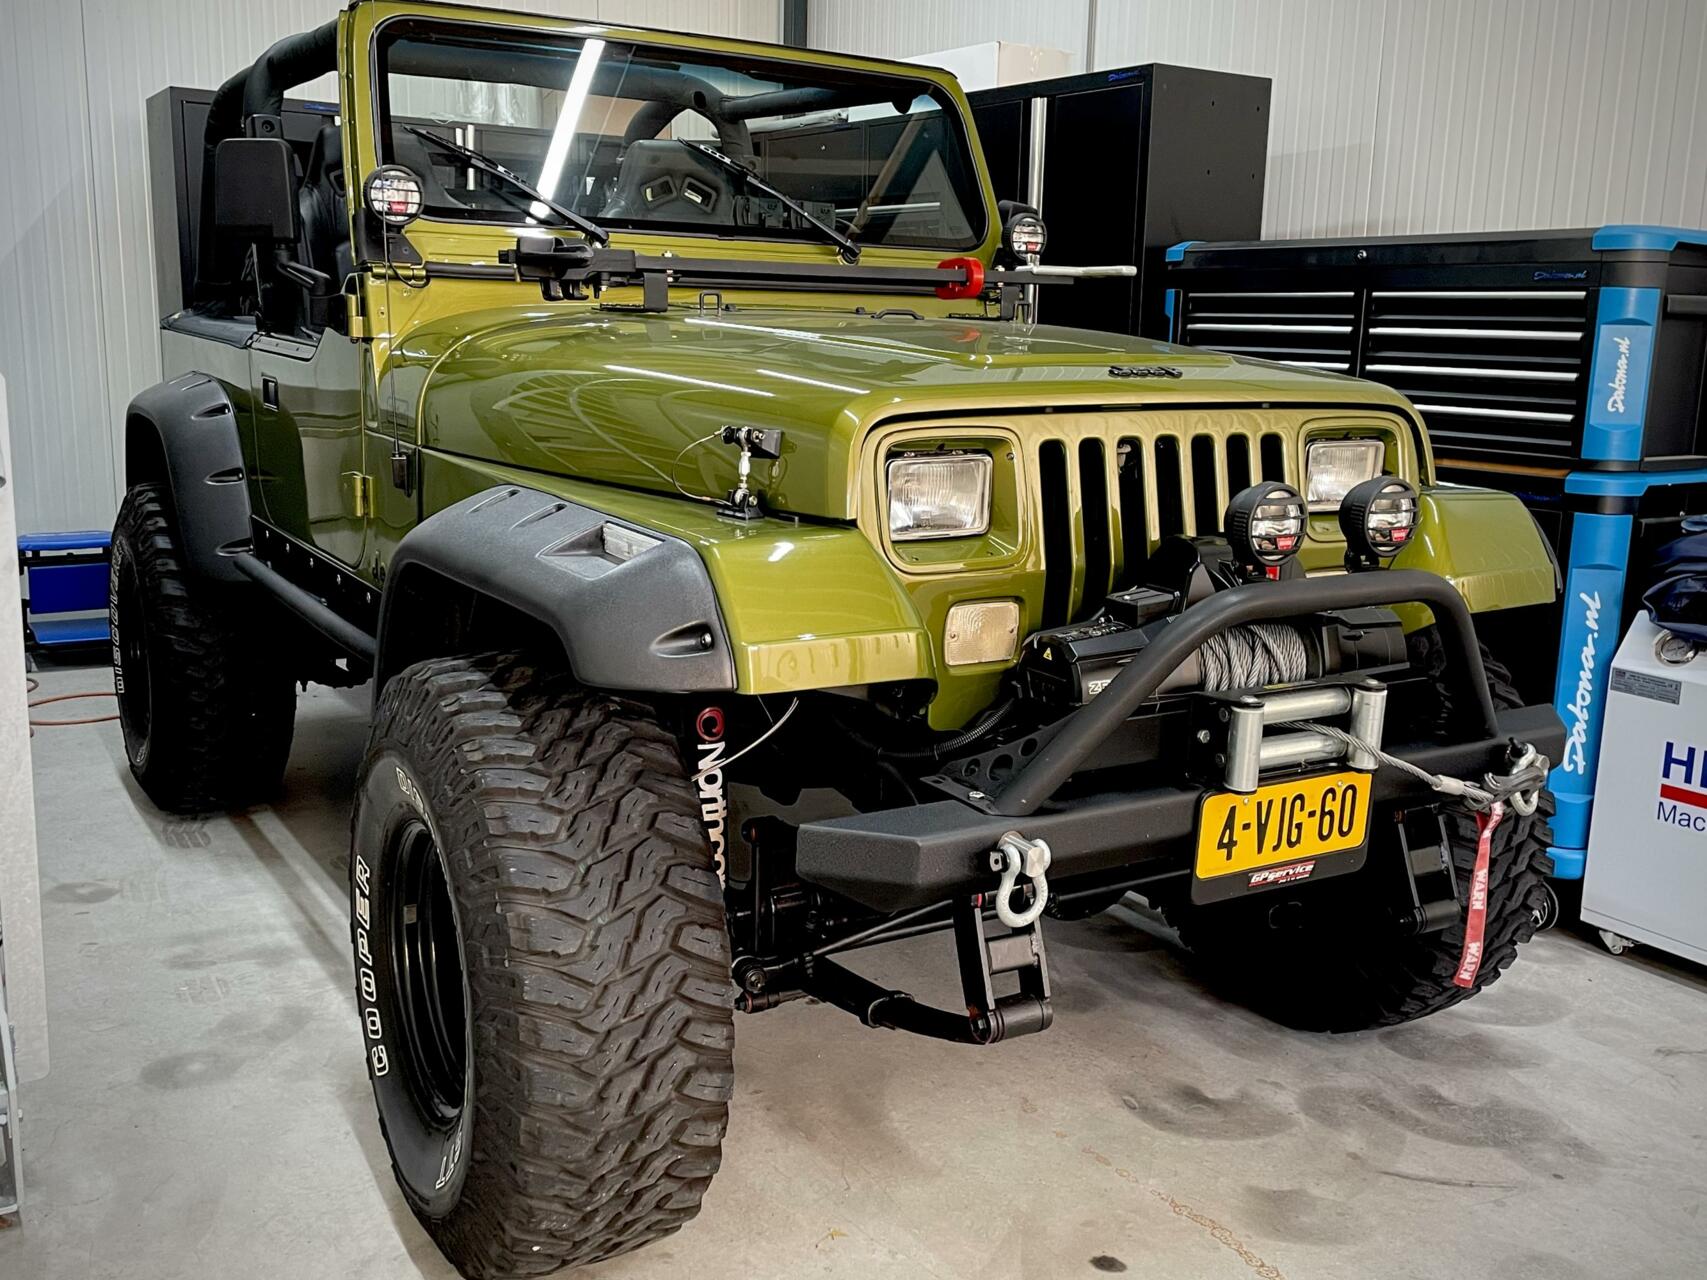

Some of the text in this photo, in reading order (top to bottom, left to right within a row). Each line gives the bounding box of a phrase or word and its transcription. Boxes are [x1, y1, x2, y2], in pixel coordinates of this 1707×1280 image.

[1607, 336, 1631, 413] Datona.nl
[1563, 591, 1602, 775] Datona.nl
[1217, 784, 1357, 861] 4-VJG-60
[1471, 868, 1488, 910] WARN
[356, 855, 389, 1077] COOPER
[1458, 941, 1482, 980] WARN
